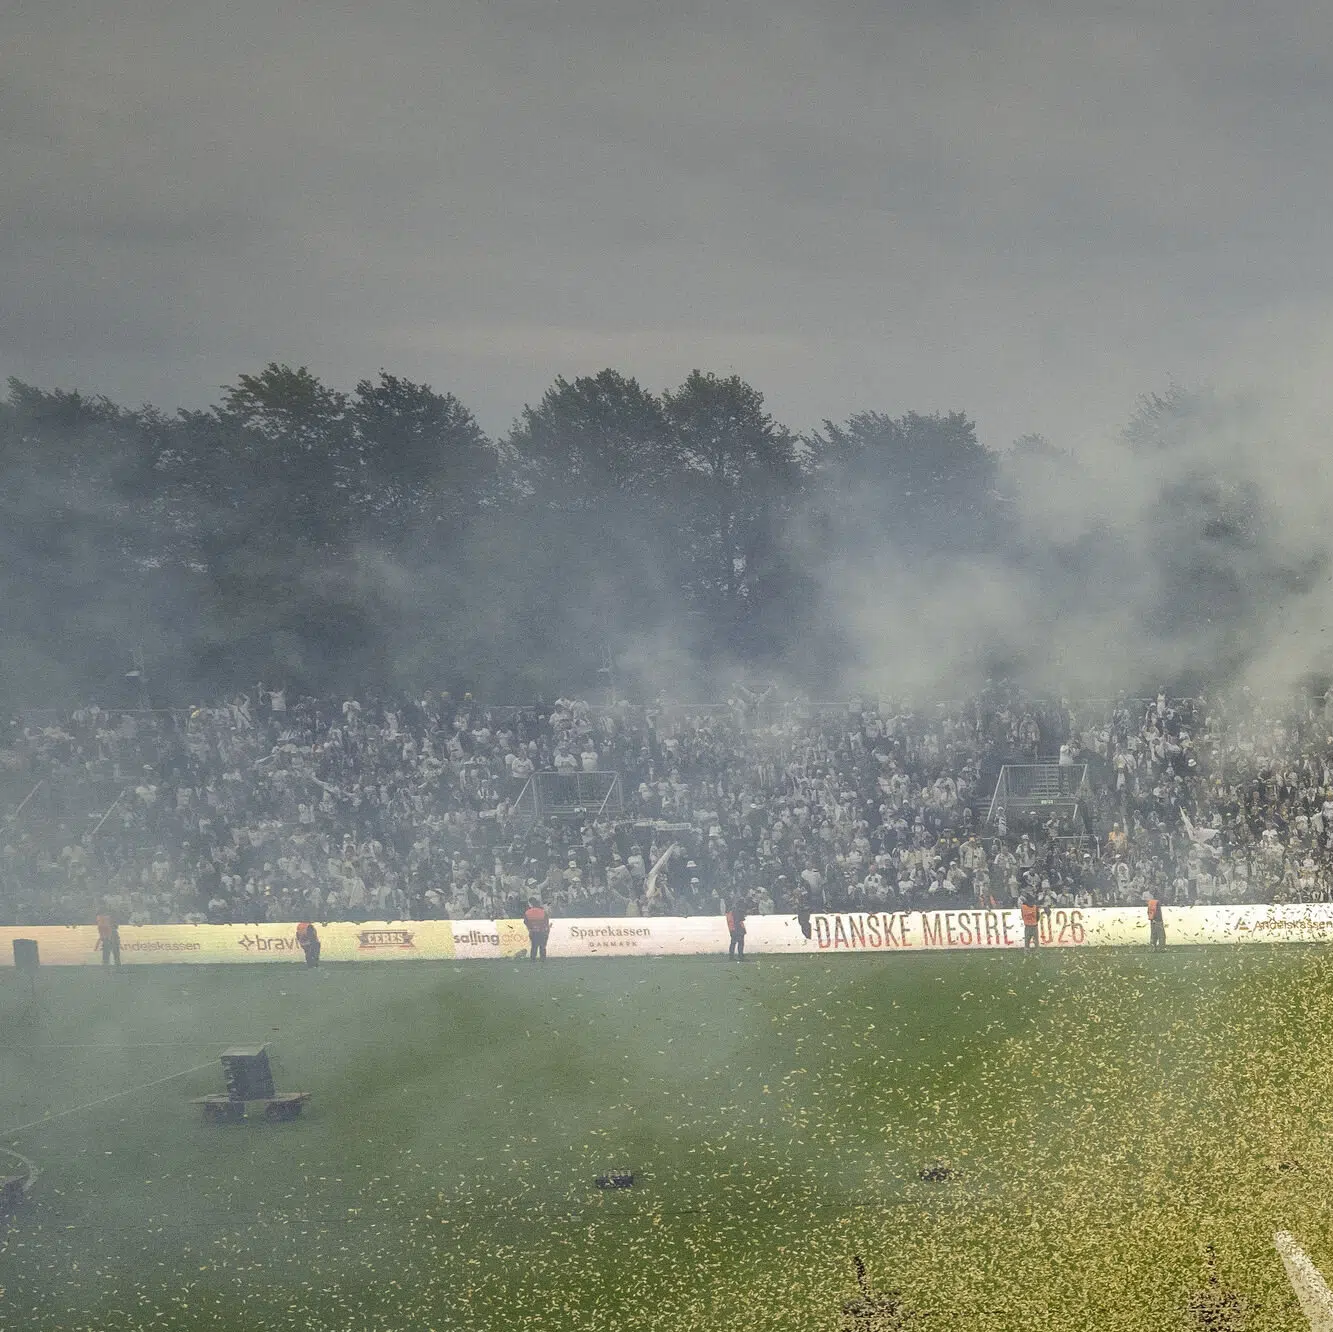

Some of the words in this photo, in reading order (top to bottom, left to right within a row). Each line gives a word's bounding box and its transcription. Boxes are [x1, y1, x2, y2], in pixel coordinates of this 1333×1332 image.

[571, 926, 650, 940] Sparekassen
[815, 911, 913, 948] DANSKE
[922, 911, 1015, 947] MESTRE
[1029, 909, 1086, 945] 026
[119, 940, 200, 951] ndelskassen
[454, 931, 500, 946] salling
